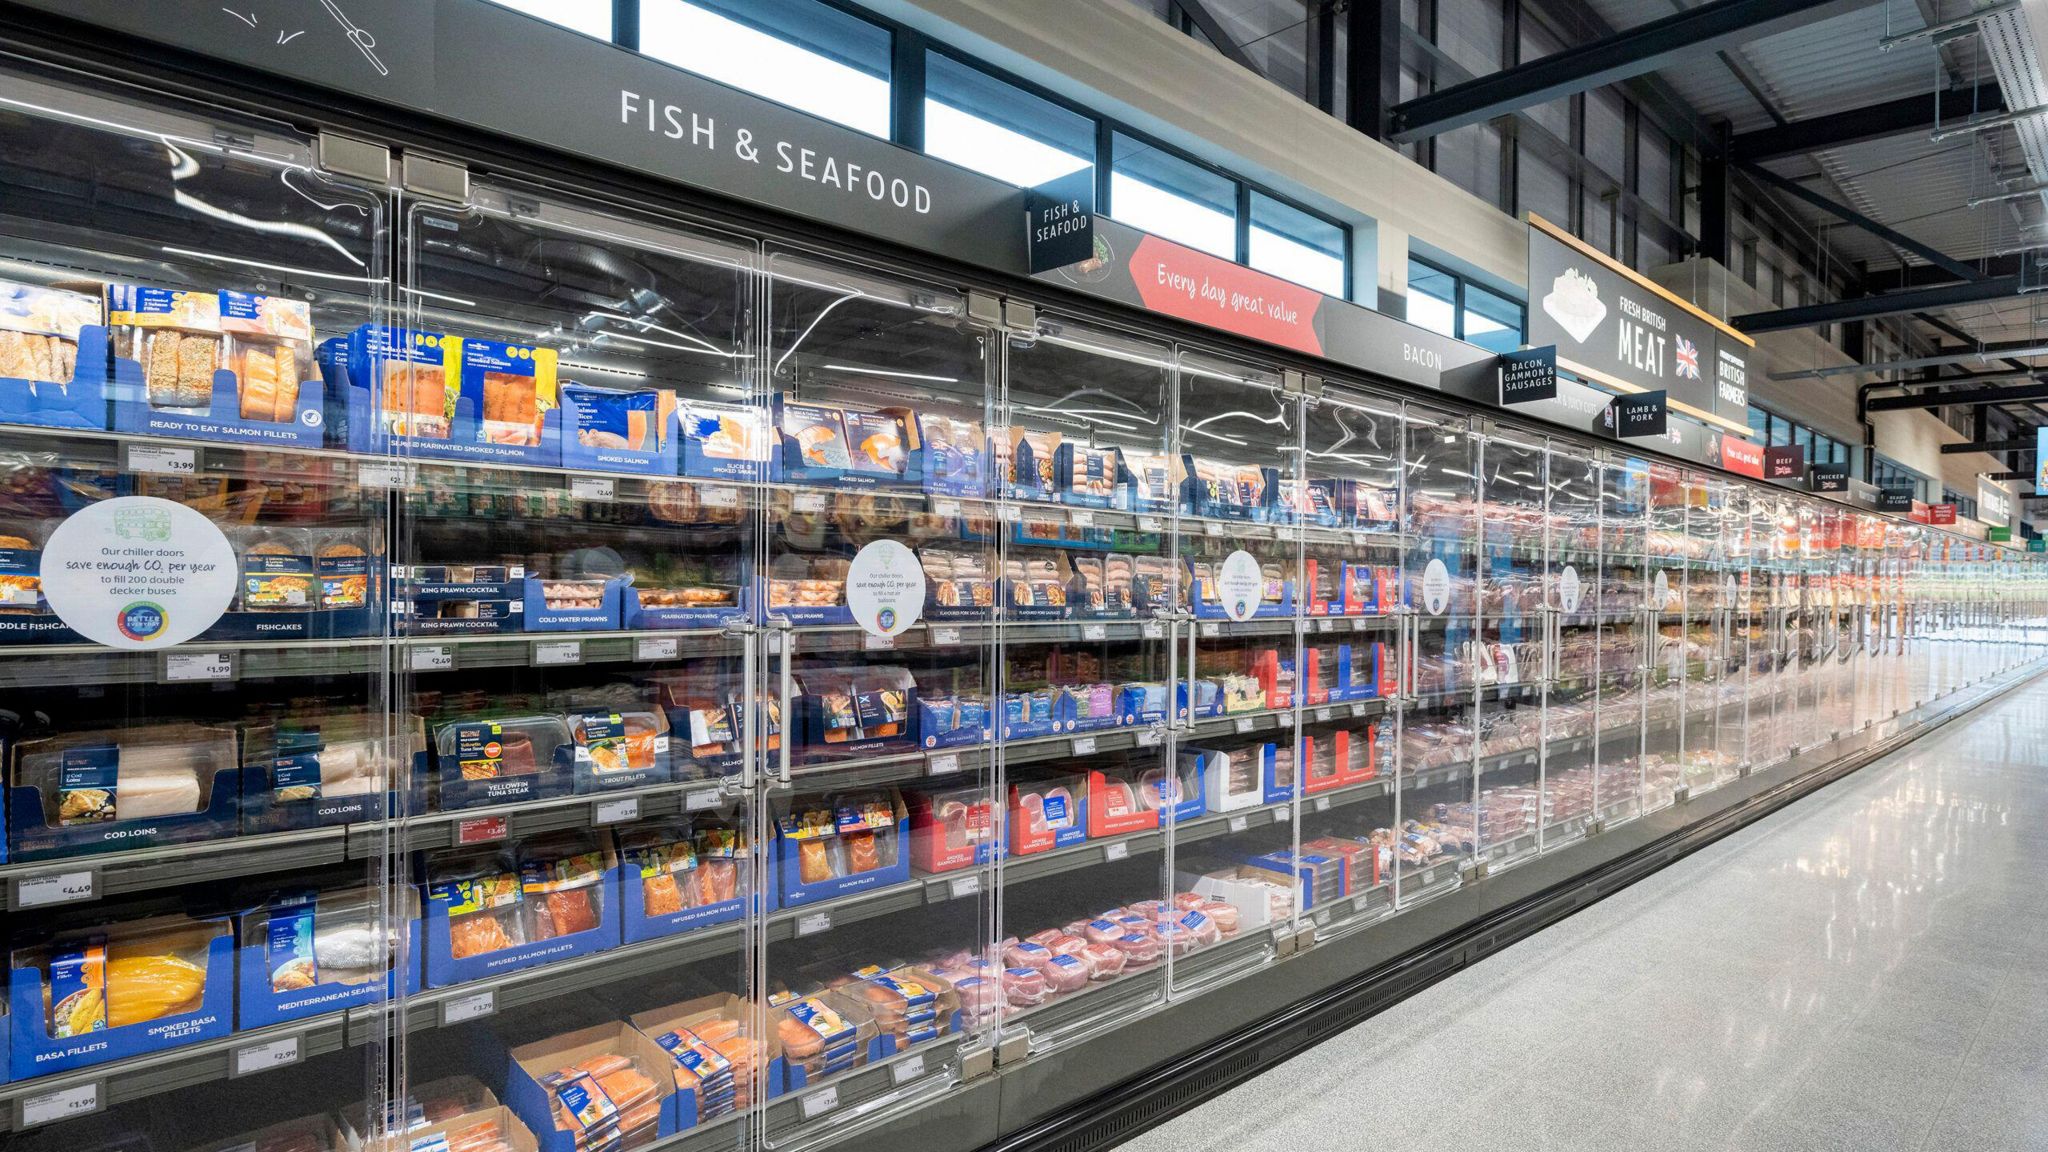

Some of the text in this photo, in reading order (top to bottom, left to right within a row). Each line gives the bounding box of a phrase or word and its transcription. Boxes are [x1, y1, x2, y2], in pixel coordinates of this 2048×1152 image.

[621, 89, 930, 214] FISH & SEAFOOD
[1044, 199, 1080, 223] FISH &
[1037, 215, 1087, 243] SEAFOOD
[1157, 263, 1298, 325] Every day great value
[1620, 296, 1666, 332] FRESH BRITISH
[1618, 318, 1665, 378] MEAT
[1404, 343, 1442, 371] BACON
[1511, 359, 1546, 371] BACON,
[1505, 367, 1554, 382] GAMMON &
[1720, 361, 1744, 386] BRITISH
[1506, 377, 1552, 392] SAUSAGES
[1719, 381, 1745, 407] FARMERS
[1626, 405, 1649, 414] LAMB
[1631, 413, 1653, 422] PORK
[150, 420, 298, 440] READY TO EAT SALMON FILLETS
[420, 442, 525, 457] MARINATED SMOKED SALMON
[168, 461, 194, 470] £3.99
[597, 455, 649, 464] SMOKED SALMON
[101, 547, 184, 557] Our chiller doors
[66, 560, 92, 570] save
[97, 559, 140, 572] enough
[169, 562, 186, 572] per
[190, 563, 216, 573] year
[101, 575, 184, 584] to fill 200 double
[110, 586, 176, 595] decker buses
[488, 781, 528, 791] YELLOWFIN
[508, 787, 529, 795] STEAK
[318, 804, 362, 816] COD LOINS
[104, 827, 157, 840] COD LOINS
[63, 885, 91, 894] £4.49
[839, 877, 875, 889] SALMON FILLETS
[672, 914, 695, 924] INFUSED
[696, 910, 719, 919] SALMON
[487, 943, 573, 968] INFUSED SALMON FILLETS
[278, 991, 350, 1011] MEDITERRANEAN
[474, 1002, 492, 1012] £3.79
[148, 1016, 216, 1036] SMOKED BASA
[164, 1026, 201, 1039] FILLETS
[36, 1042, 108, 1062] BASA FILLETS
[274, 1050, 296, 1060] £2.99
[69, 1098, 95, 1108] £1.99
